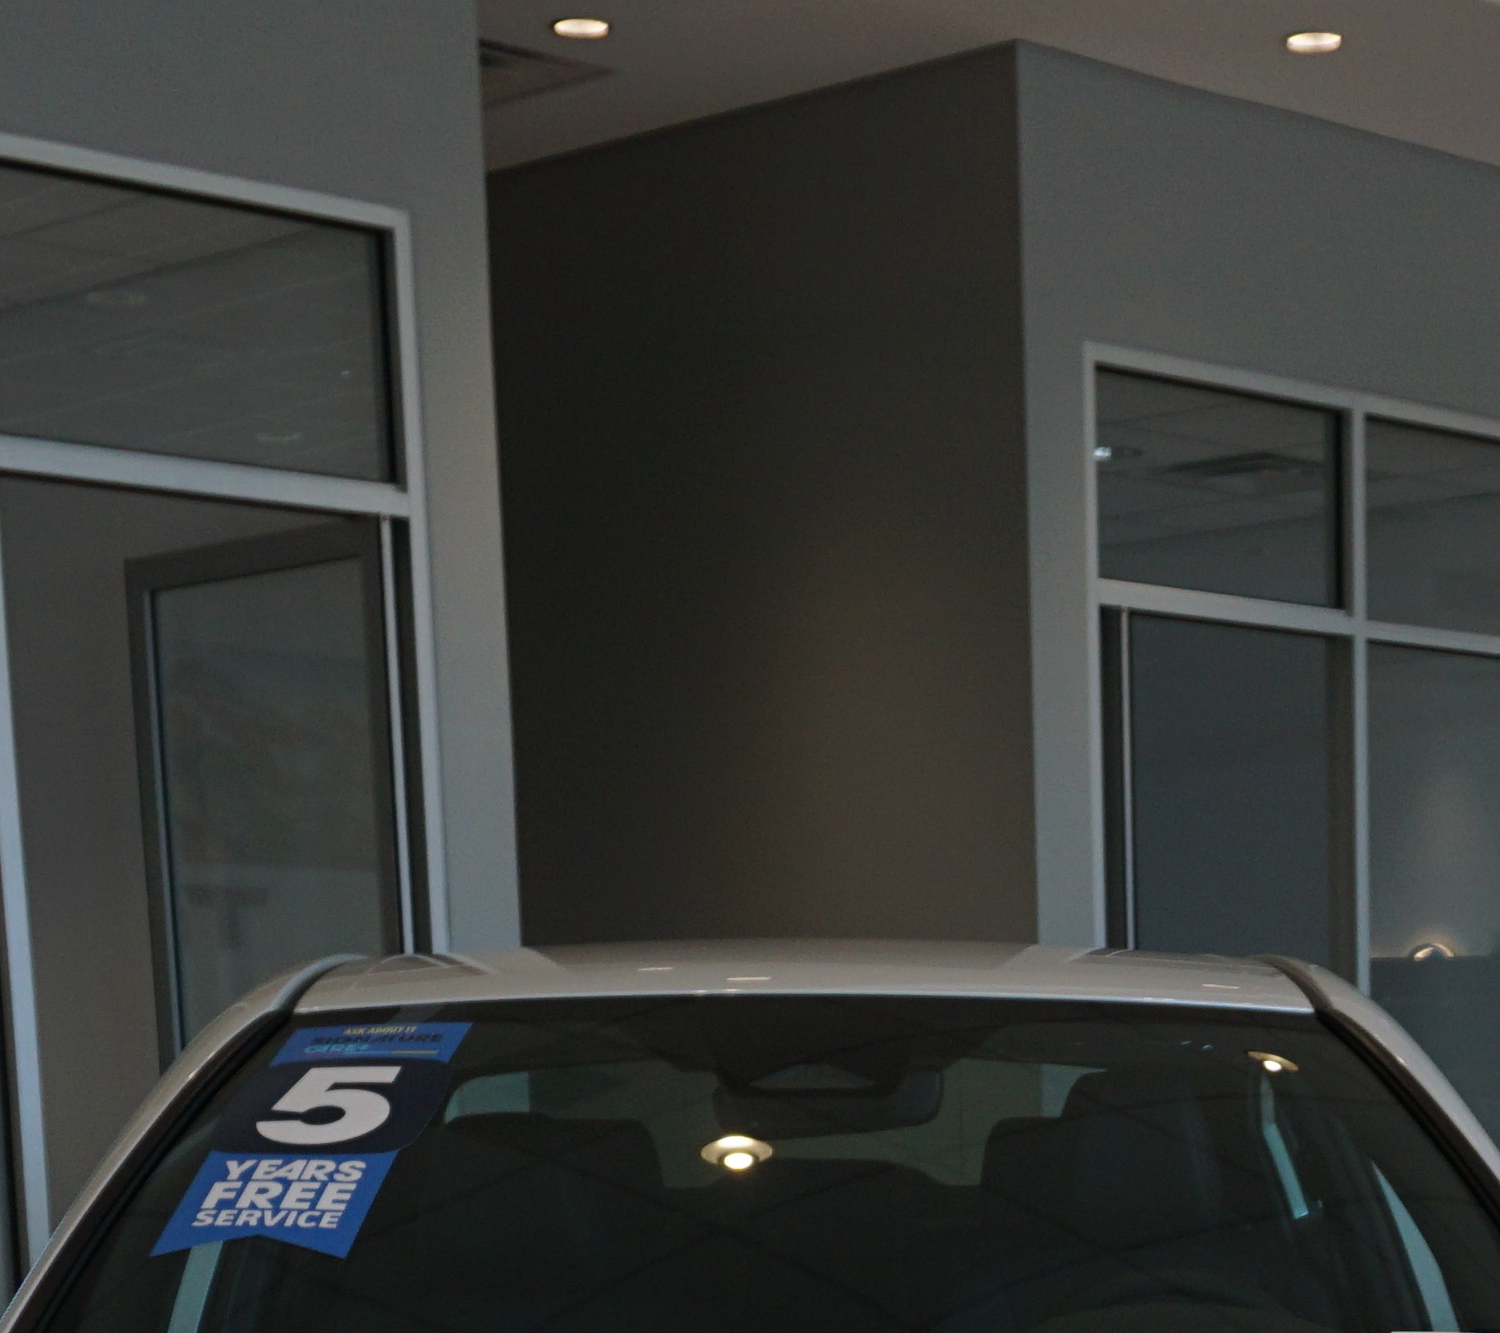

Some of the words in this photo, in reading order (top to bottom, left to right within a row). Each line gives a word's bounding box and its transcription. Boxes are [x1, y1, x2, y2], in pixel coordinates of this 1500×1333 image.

[256, 1066, 402, 1145] 5
[224, 1159, 367, 1181] YEARS
[200, 1180, 357, 1210] FREE
[192, 1209, 343, 1228] SERVICE
